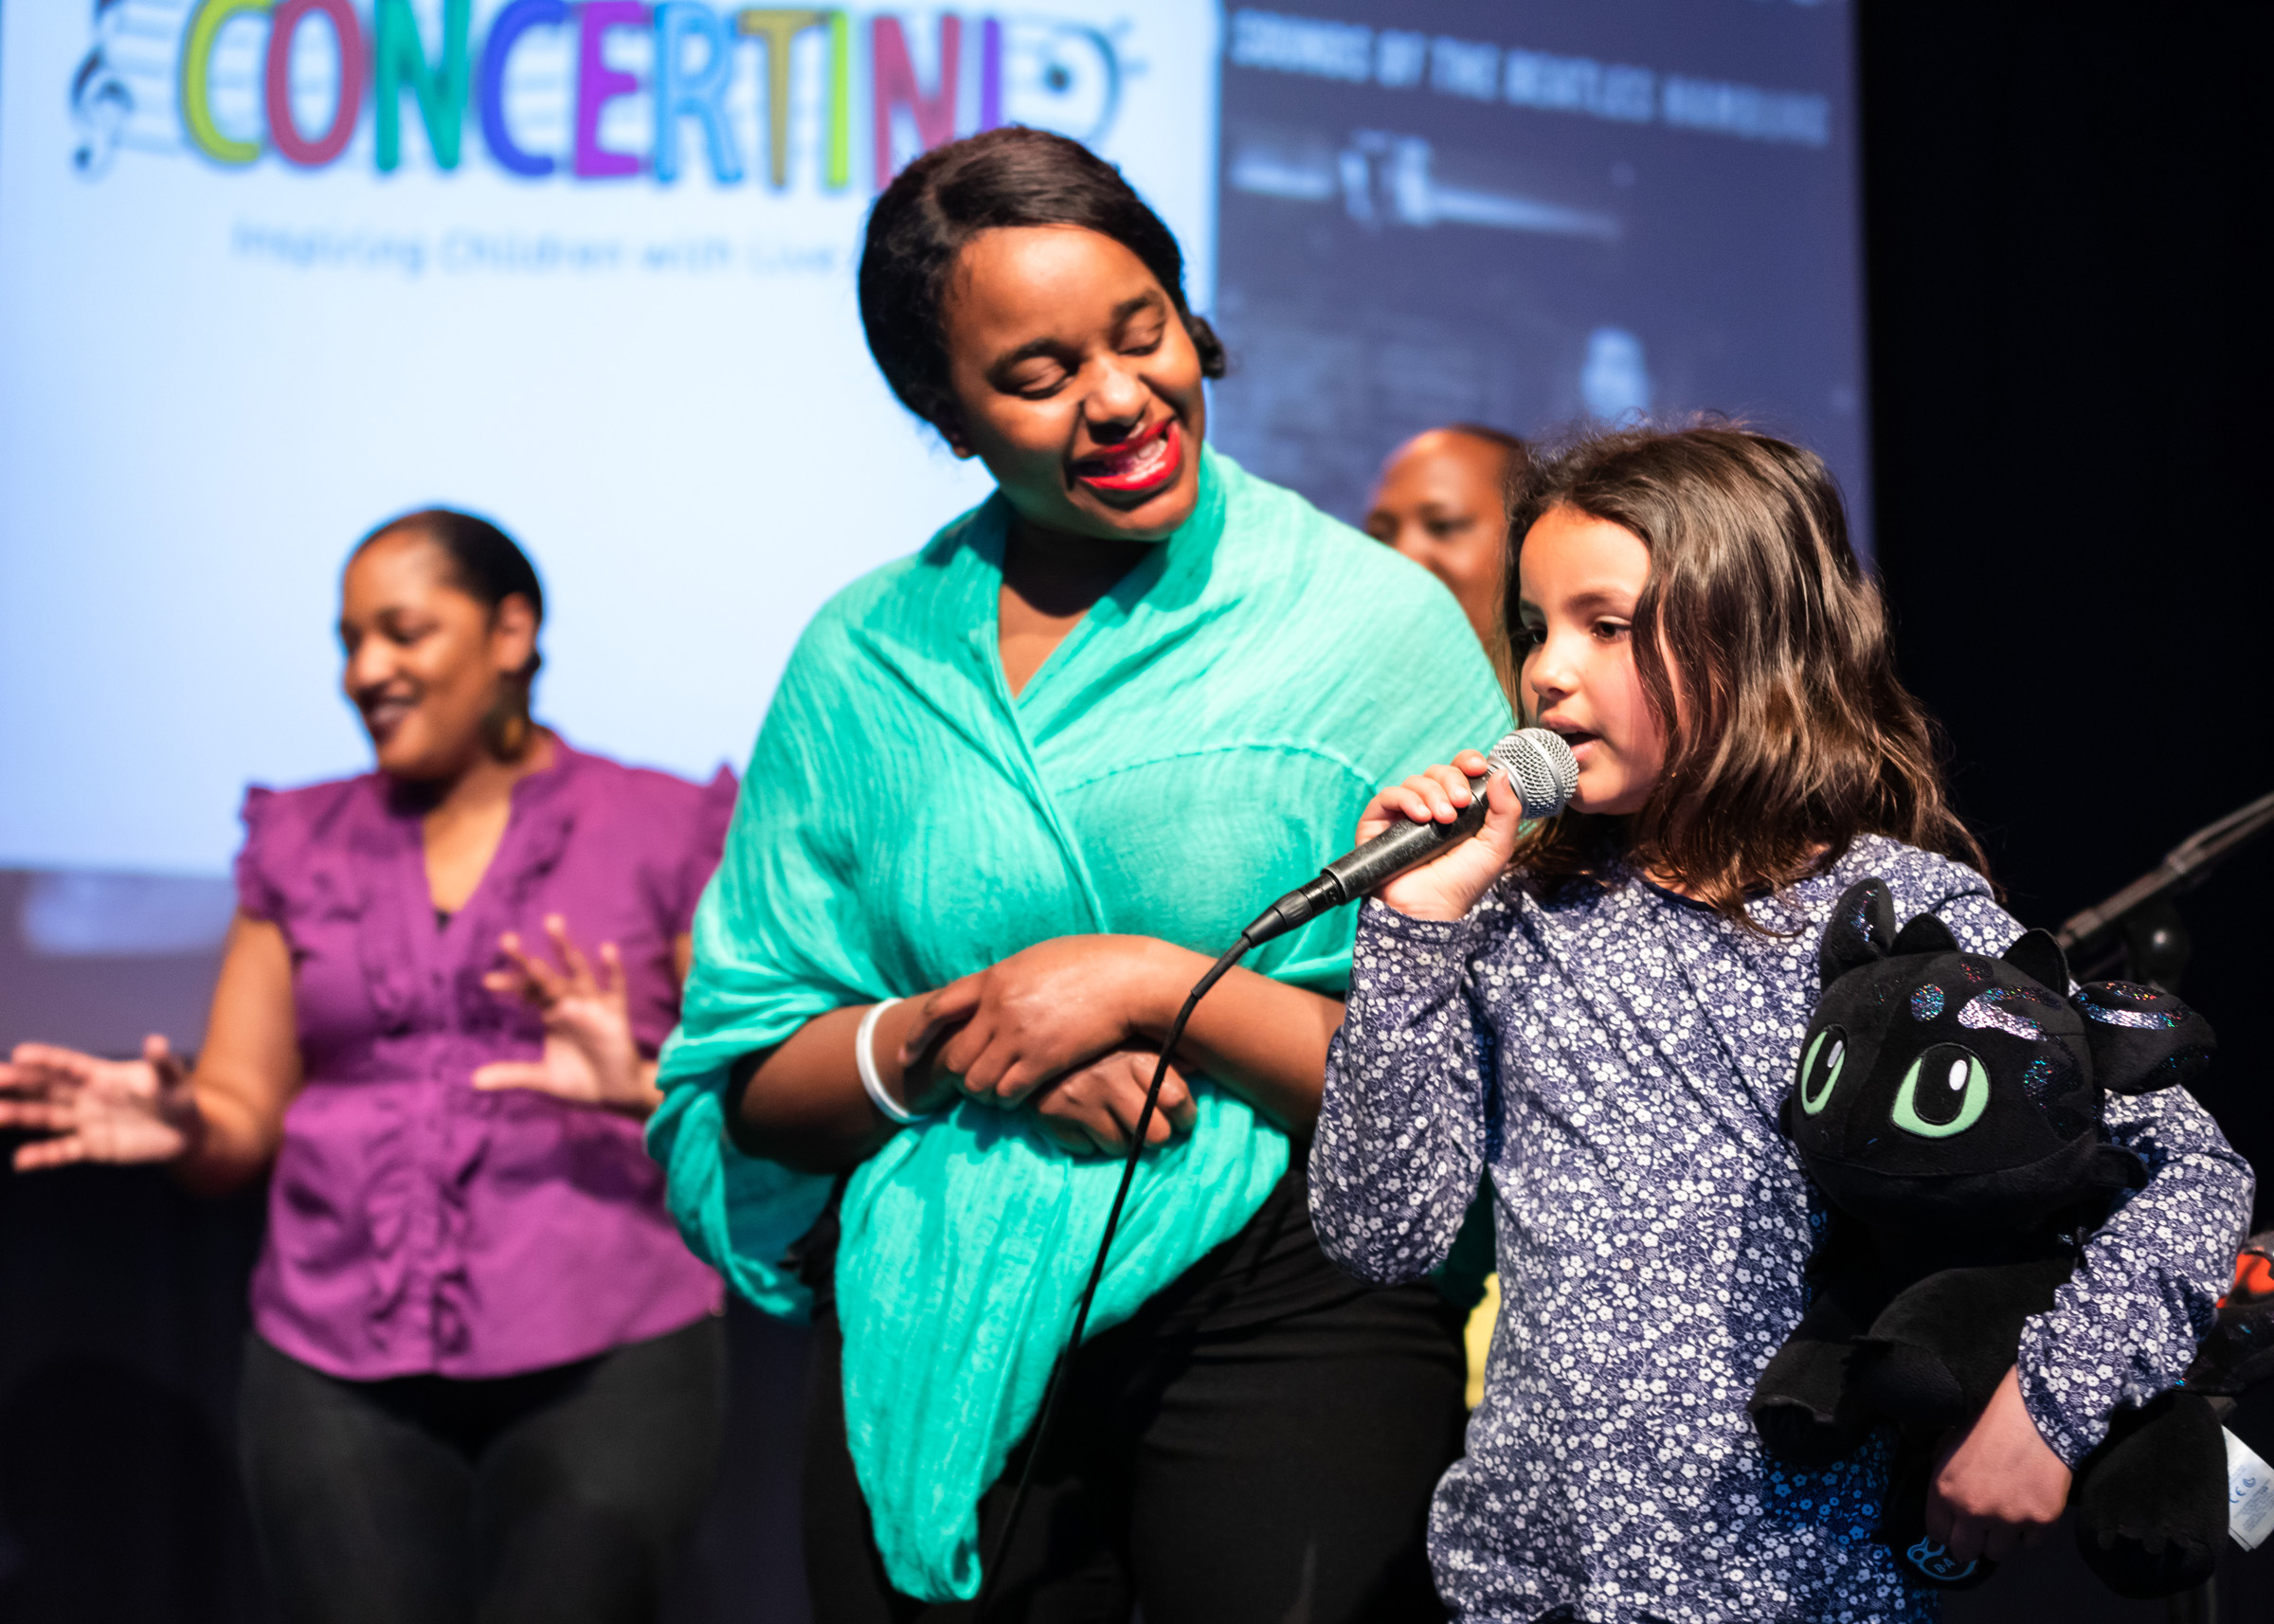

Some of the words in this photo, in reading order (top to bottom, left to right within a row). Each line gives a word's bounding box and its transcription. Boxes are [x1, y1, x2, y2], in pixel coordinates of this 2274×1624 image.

[1430, 38, 1498, 100] THE
[1507, 50, 1654, 122] BEATLES
[441, 225, 623, 274] Children
[641, 232, 731, 272] with
